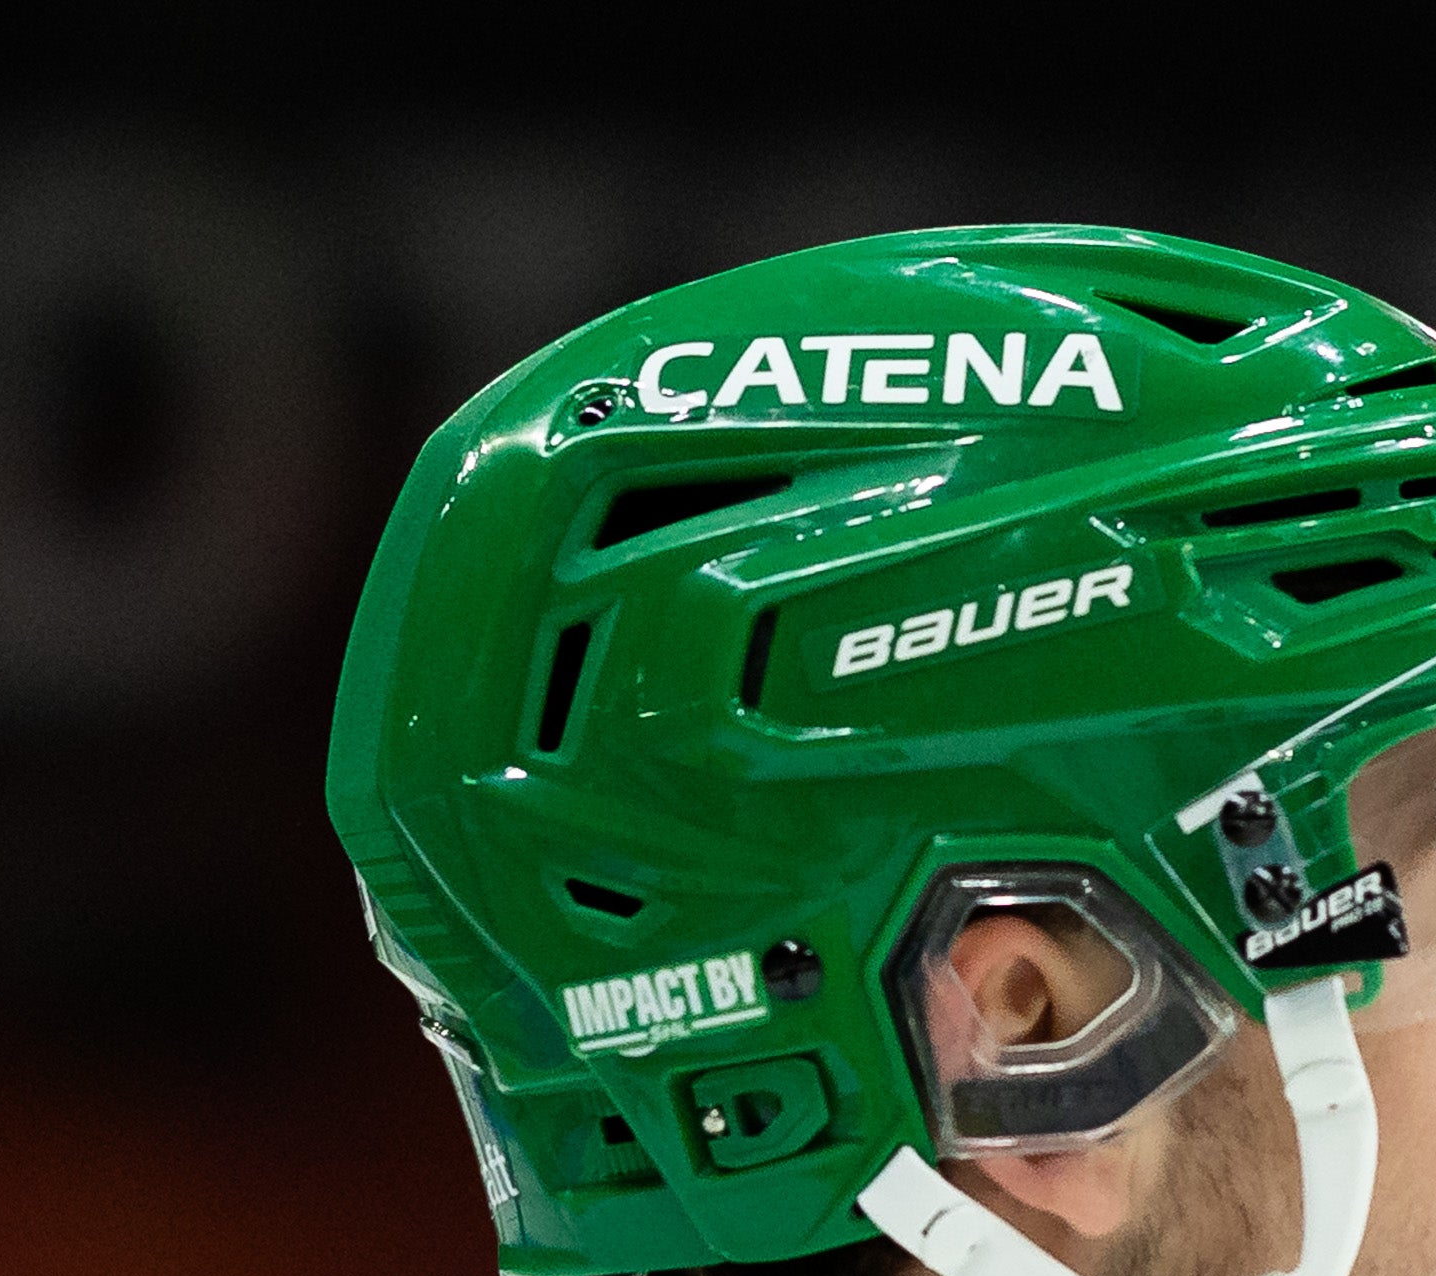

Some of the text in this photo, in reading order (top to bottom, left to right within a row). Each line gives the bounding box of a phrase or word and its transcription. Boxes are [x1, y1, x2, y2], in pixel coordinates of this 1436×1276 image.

[637, 331, 1124, 413] CATENA
[562, 950, 757, 1038] IMPACT BY
